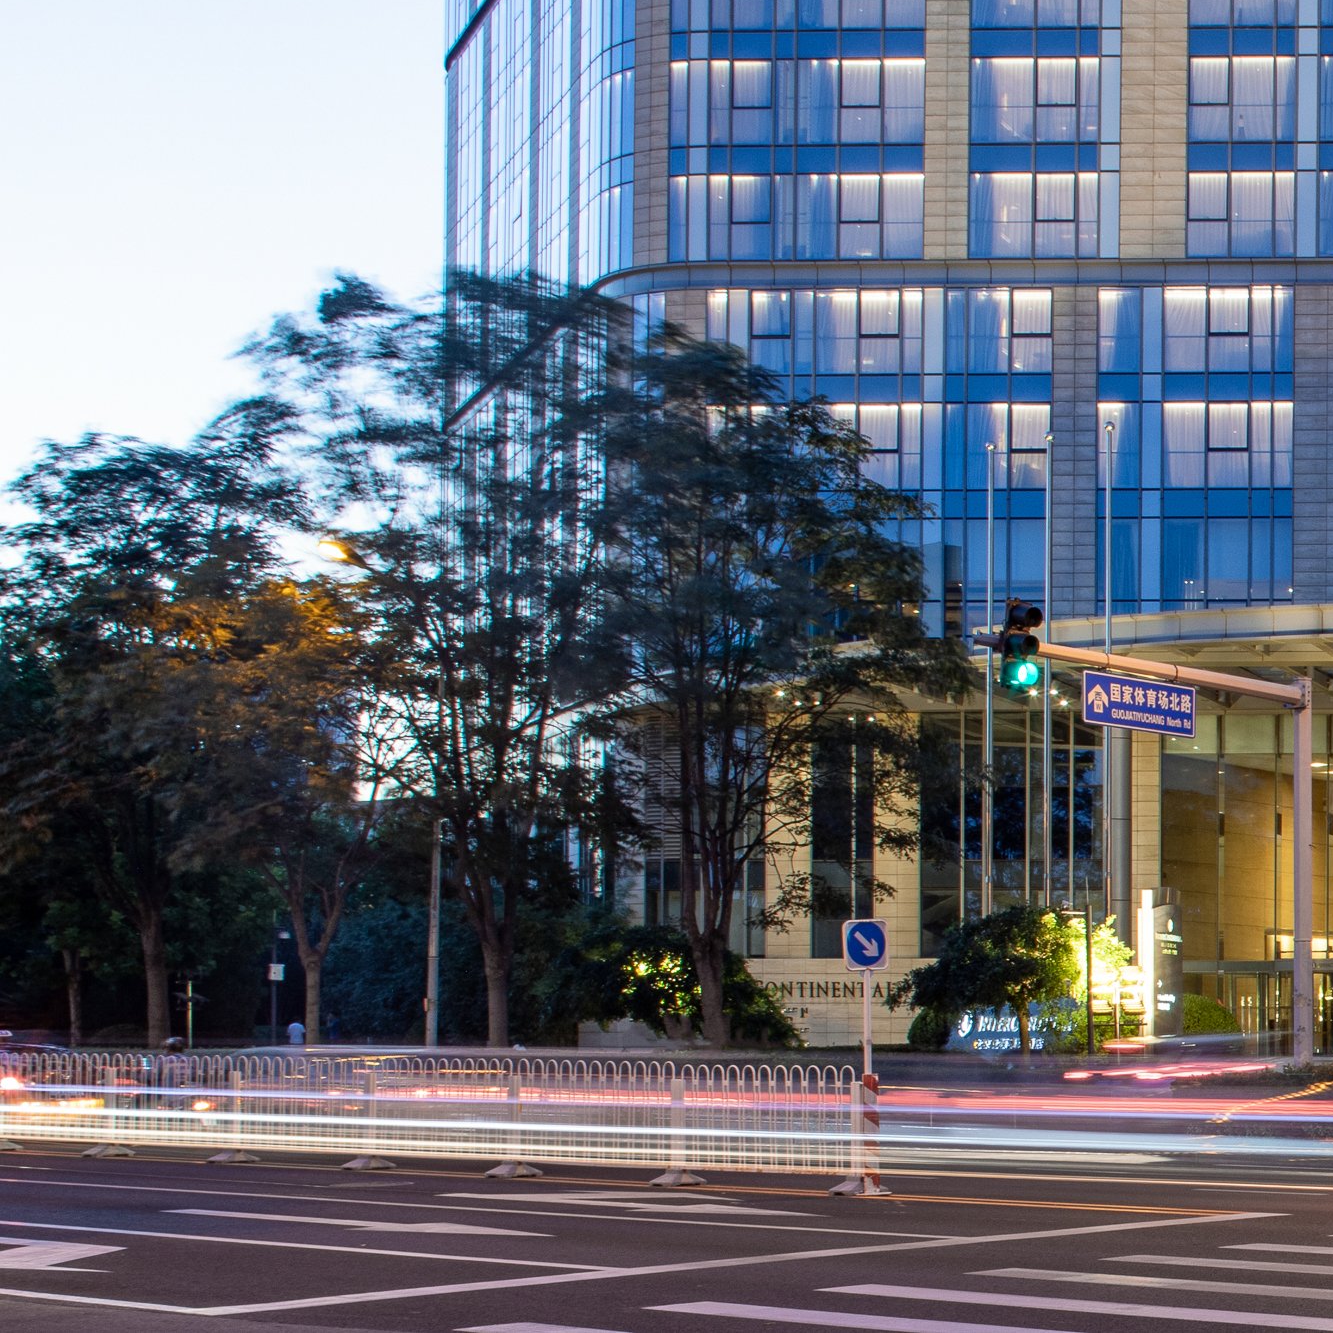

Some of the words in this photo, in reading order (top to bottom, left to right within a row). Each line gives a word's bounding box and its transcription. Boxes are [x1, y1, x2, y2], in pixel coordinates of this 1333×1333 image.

[1110, 683, 1192, 714] 国家体育场北路
[1166, 717, 1182, 728] North
[1183, 719, 1192, 730] Rd
